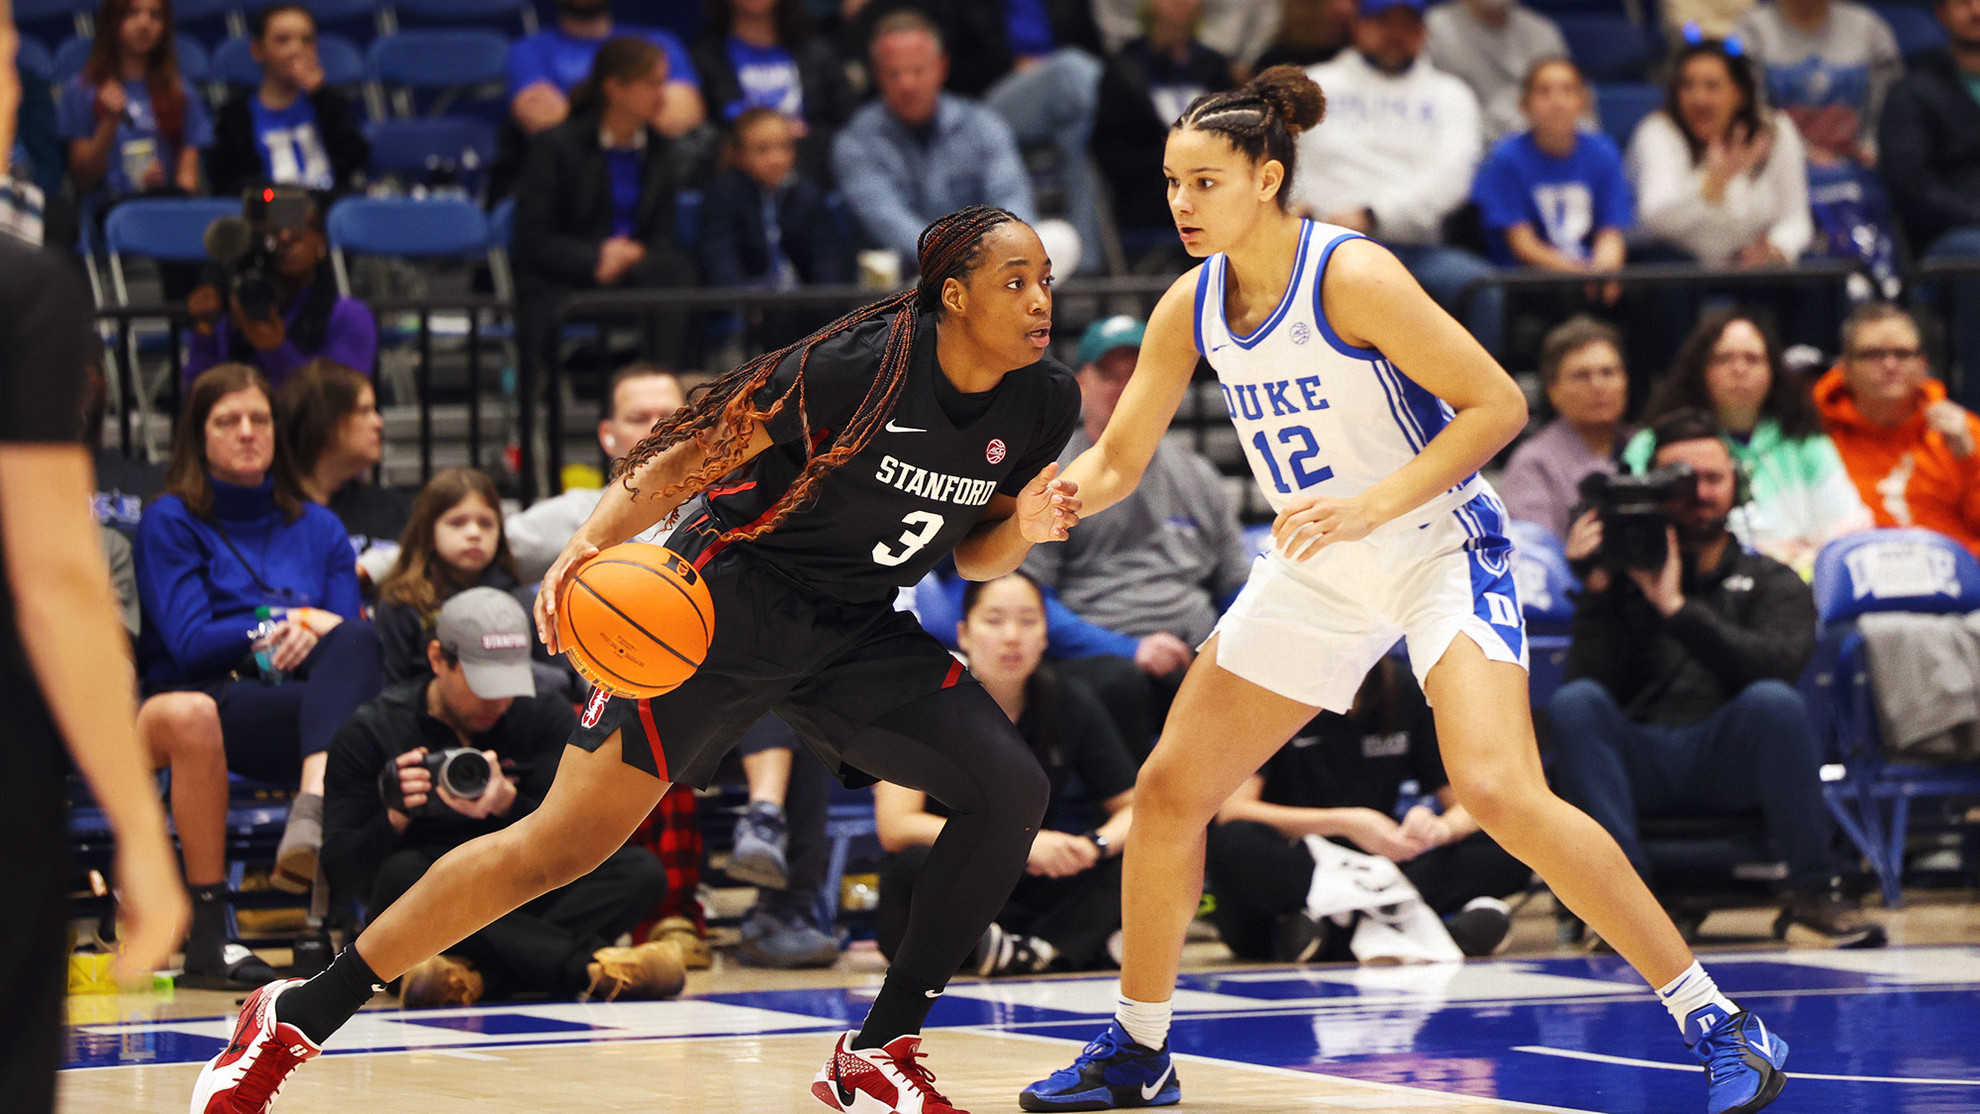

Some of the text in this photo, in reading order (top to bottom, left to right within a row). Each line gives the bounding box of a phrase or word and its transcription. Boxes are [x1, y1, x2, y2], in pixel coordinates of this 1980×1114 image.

[875, 455, 998, 506] STANFORD
[1252, 425, 1334, 493] 12
[872, 510, 945, 567] 3
[1482, 591, 1520, 629] D
